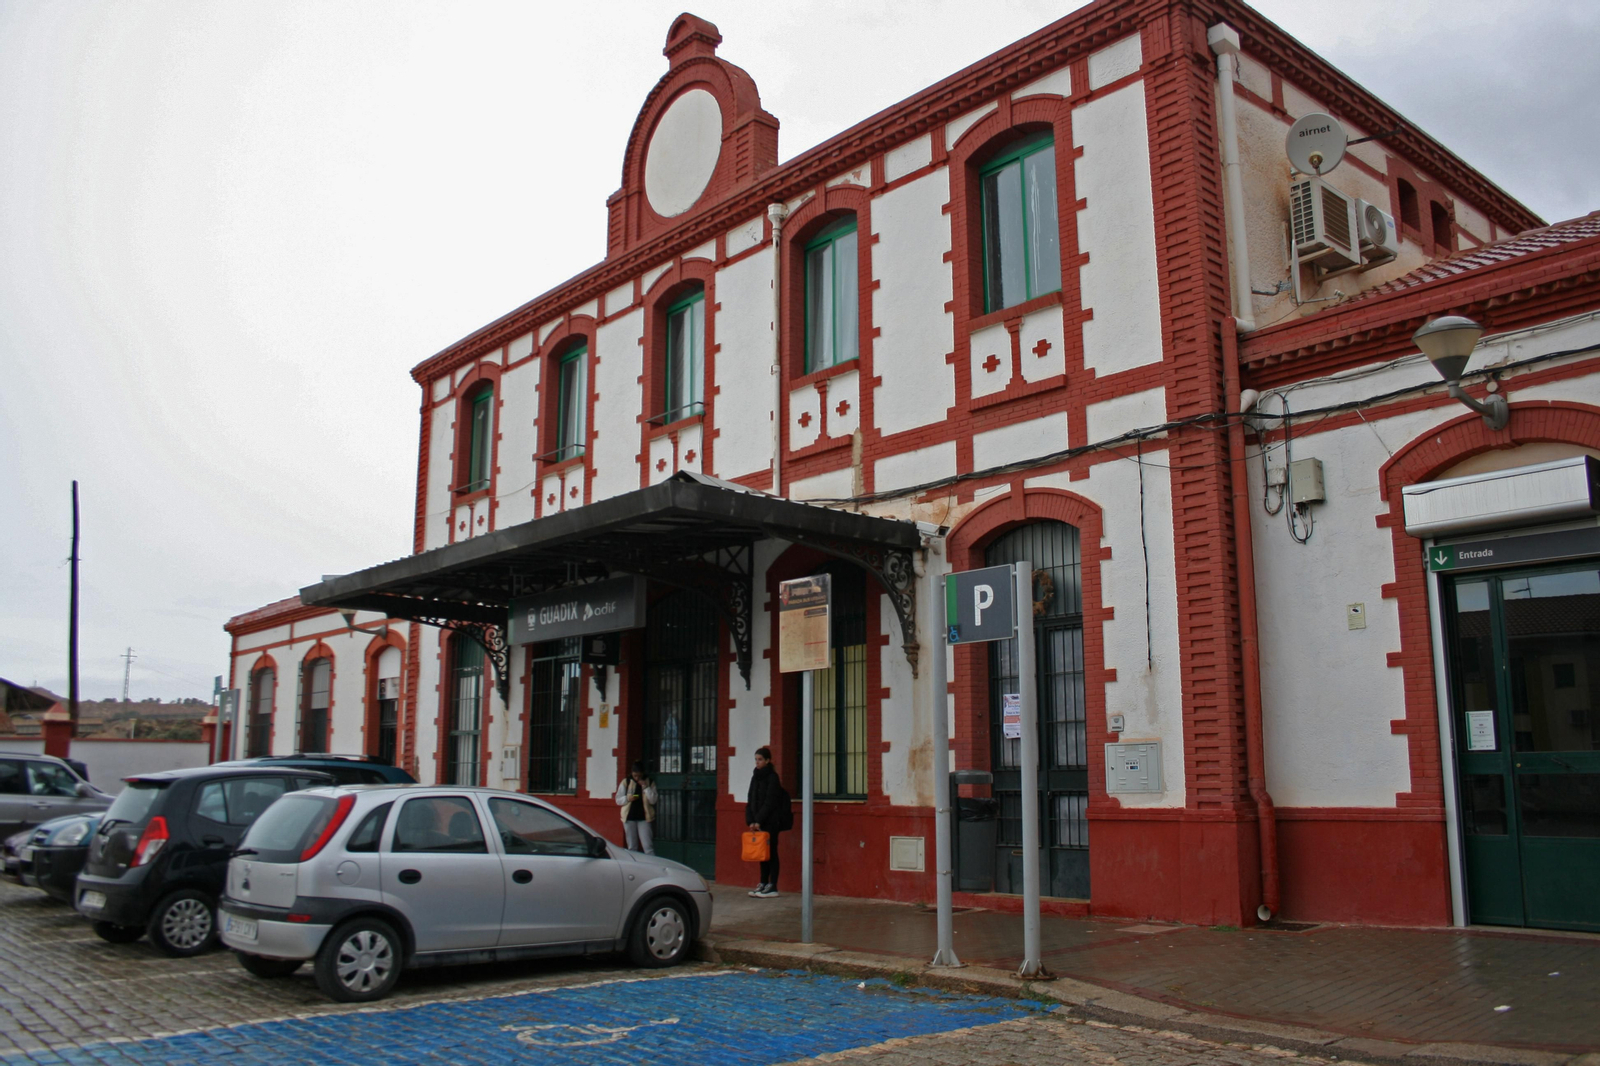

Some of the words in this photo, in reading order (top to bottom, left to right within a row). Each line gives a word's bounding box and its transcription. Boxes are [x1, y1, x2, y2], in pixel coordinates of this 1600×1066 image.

[1299, 124, 1331, 138] airnet
[1459, 549, 1493, 560] Entrada
[539, 601, 578, 625] GUADIX
[594, 601, 617, 616] adif
[973, 584, 994, 627] P
